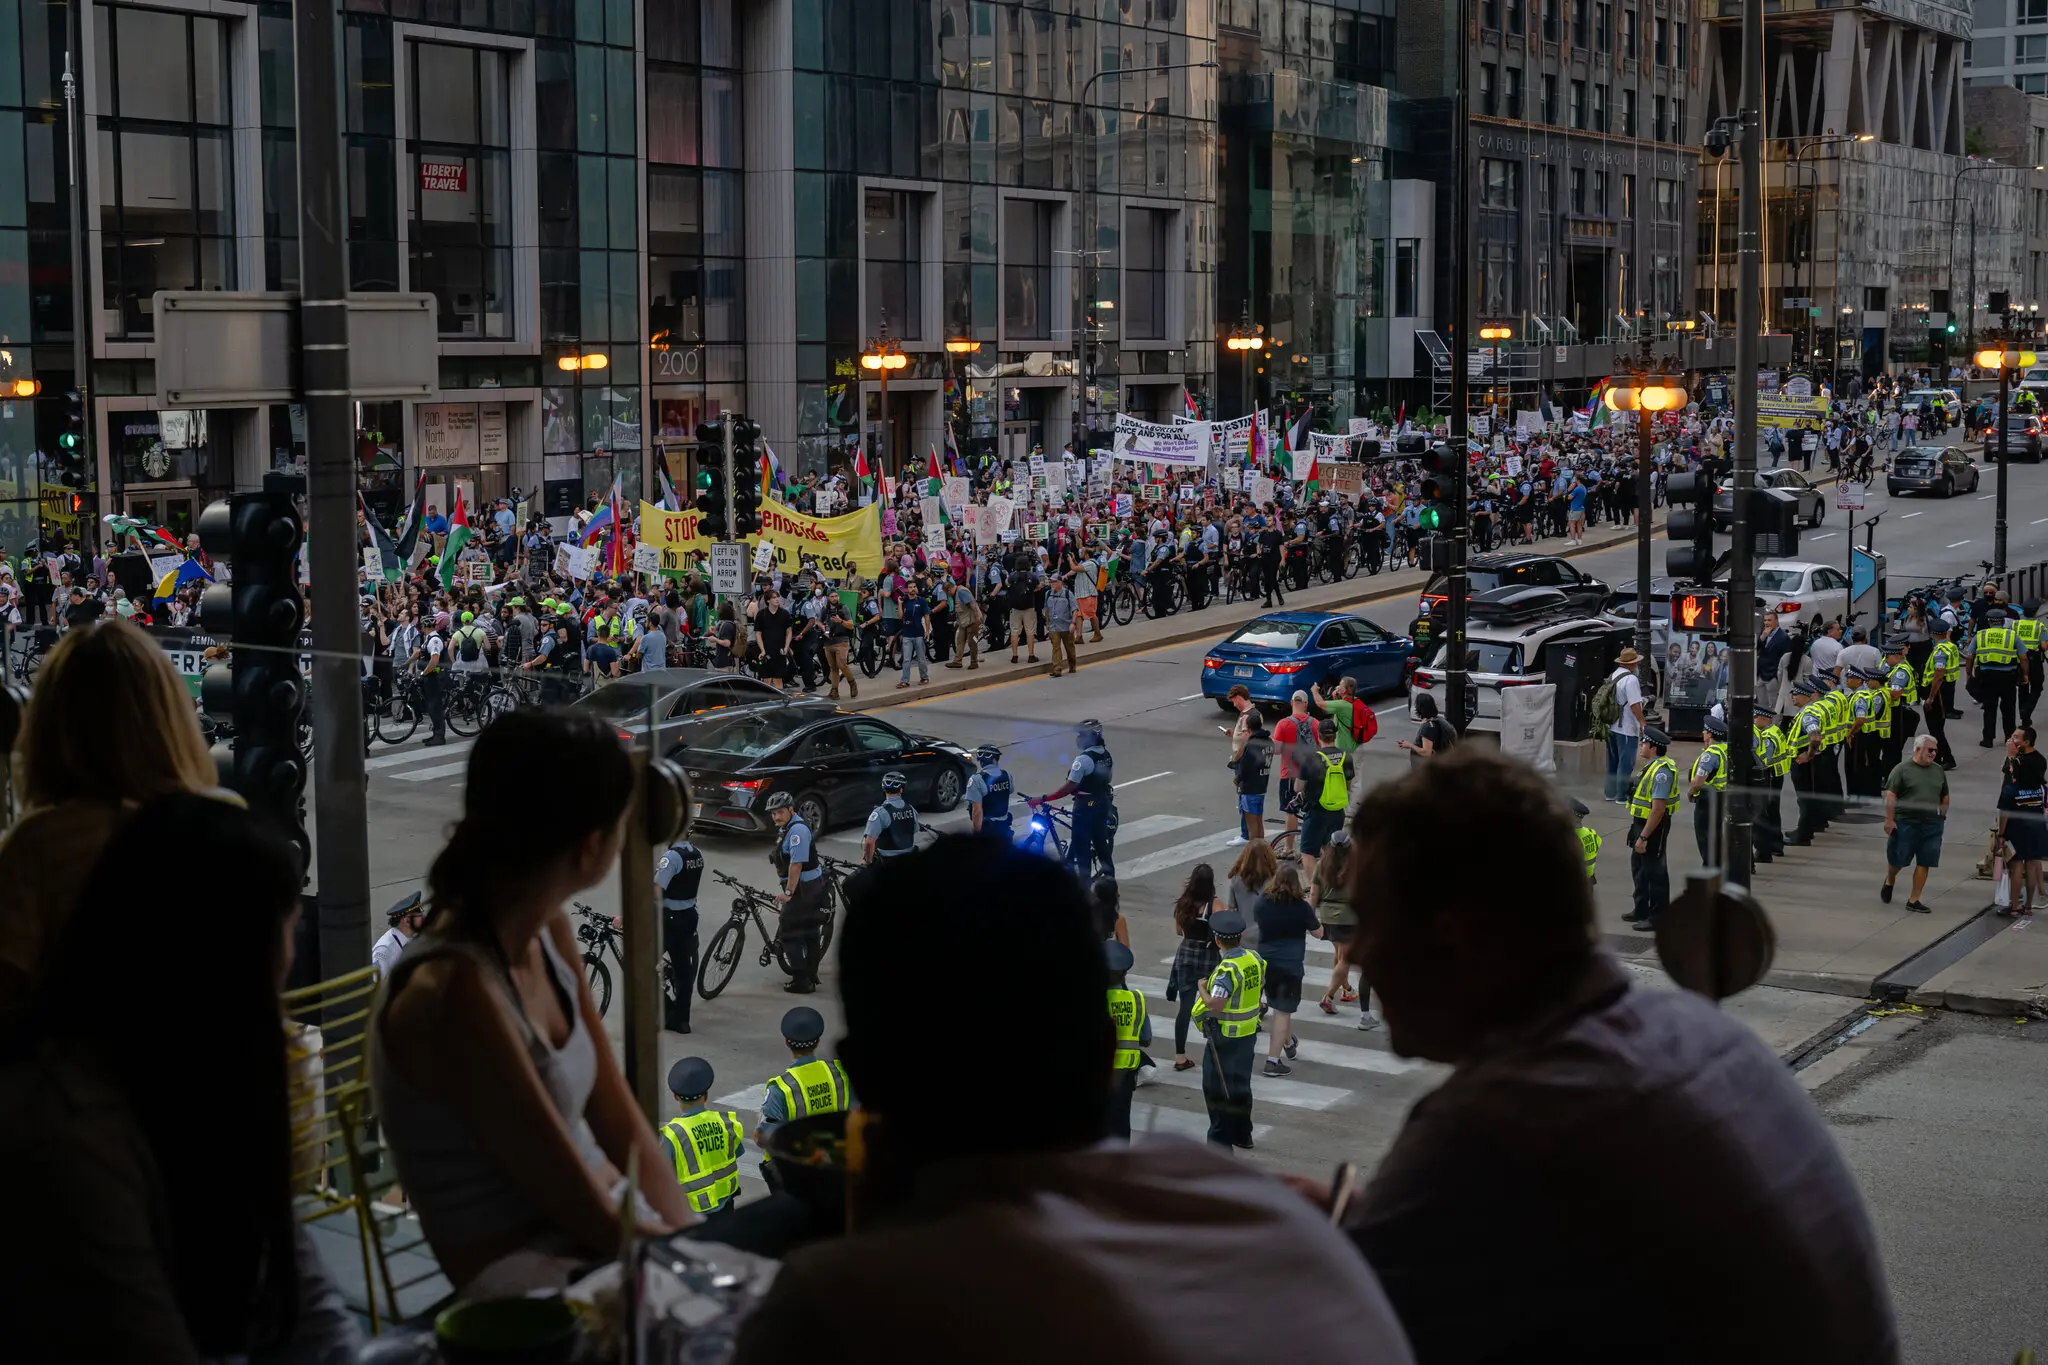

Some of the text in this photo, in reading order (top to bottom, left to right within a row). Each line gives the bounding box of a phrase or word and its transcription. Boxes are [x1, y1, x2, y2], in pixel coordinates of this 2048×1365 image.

[1478, 134, 1537, 154] CARBIDE
[1583, 148, 1628, 166] CARBON
[423, 164, 463, 177] LIBERTY
[424, 177, 460, 190] TRAVEL
[659, 351, 698, 376] 200
[425, 412, 440, 427] 200
[1121, 418, 1142, 429] LEGAL
[425, 429, 445, 443] North
[1114, 426, 1189, 441] ONCE AND FOR ALL!
[425, 445, 460, 461] Michigan
[1328, 479, 1351, 490] VTE
[664, 515, 699, 543] STOP
[663, 545, 677, 569] No
[714, 547, 739, 556] LEFT ON
[717, 558, 737, 567] GREEN
[717, 569, 737, 578] ARROW
[720, 580, 735, 589] ONLY
[989, 780, 1009, 793] POLICE
[892, 809, 913, 821] POLICE
[686, 858, 703, 870] POLICE
[1242, 963, 1258, 979] CHICAGO
[1243, 975, 1260, 991] POLICE
[1111, 1001, 1133, 1013] CHICAGO
[807, 1082, 830, 1098] CHICAGO
[810, 1094, 832, 1111] POLICE
[691, 1121, 724, 1141] CHICAGO
[696, 1135, 725, 1155] POLICE
